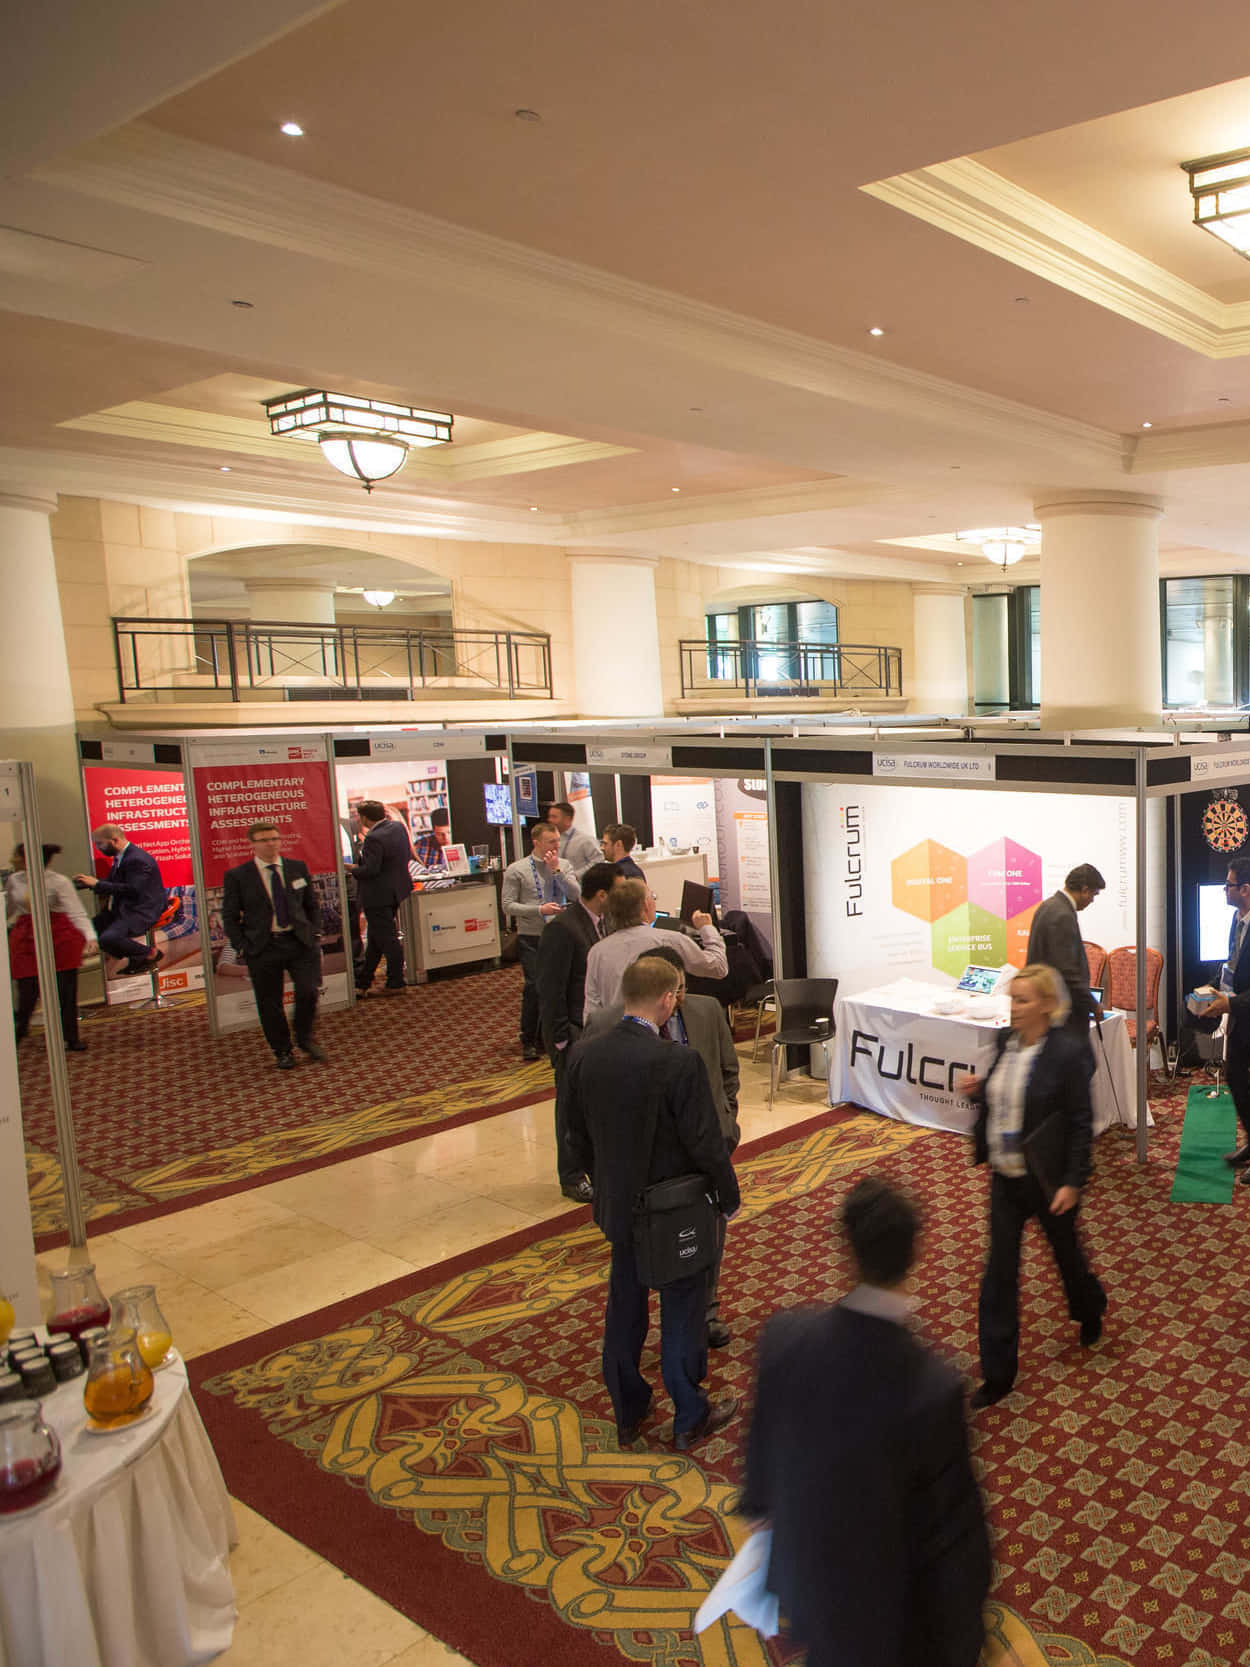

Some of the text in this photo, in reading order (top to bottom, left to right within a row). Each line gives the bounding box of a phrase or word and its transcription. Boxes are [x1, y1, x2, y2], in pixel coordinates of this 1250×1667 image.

[207, 777, 305, 791] COMPLEMENTARY
[207, 789, 305, 804] HETEROGENEOUS
[208, 801, 307, 816] INFRASTRUCTURE
[844, 805, 863, 917] Fulcrum
[851, 1029, 975, 1092] Fulcr
[920, 1093, 954, 1106] THOUGHT
